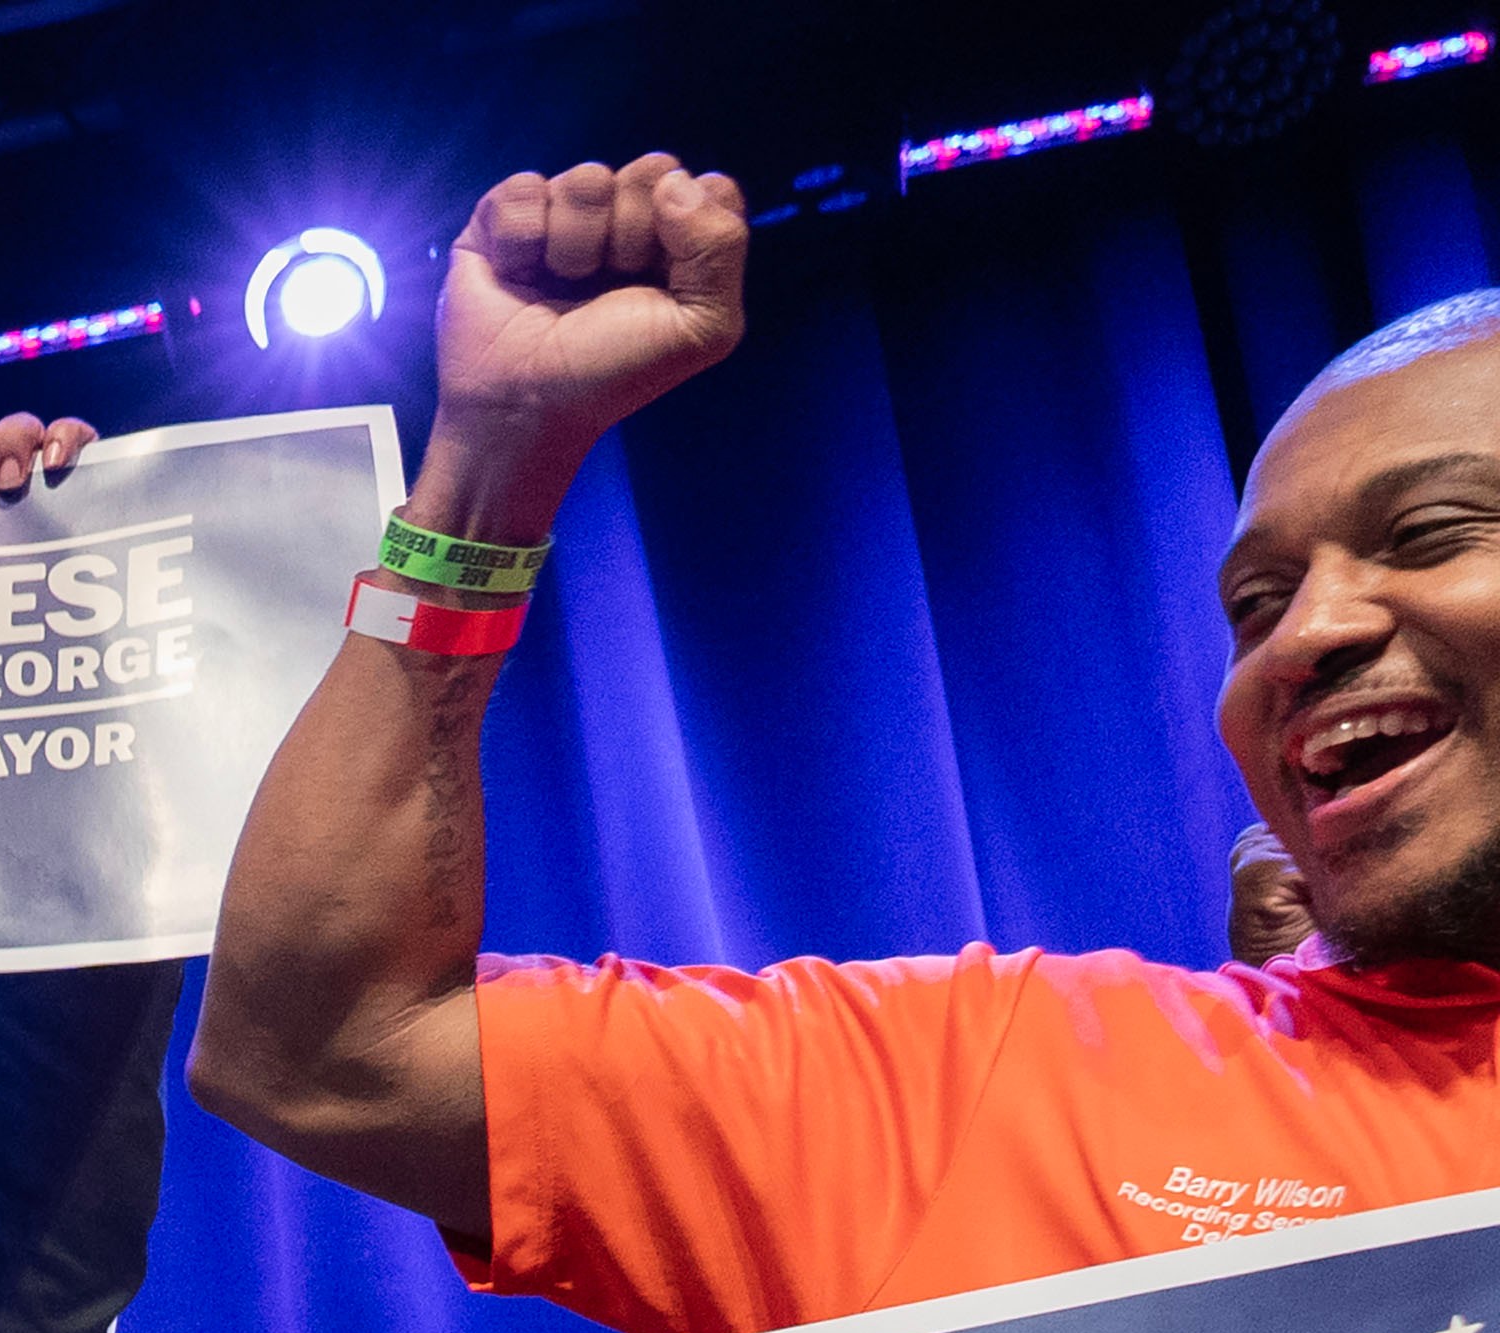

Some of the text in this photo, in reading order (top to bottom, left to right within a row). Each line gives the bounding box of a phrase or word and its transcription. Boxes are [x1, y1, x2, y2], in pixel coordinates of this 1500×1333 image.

[1117, 1181, 1251, 1231] Recording
[1164, 1166, 1348, 1208] Barry Wilson
